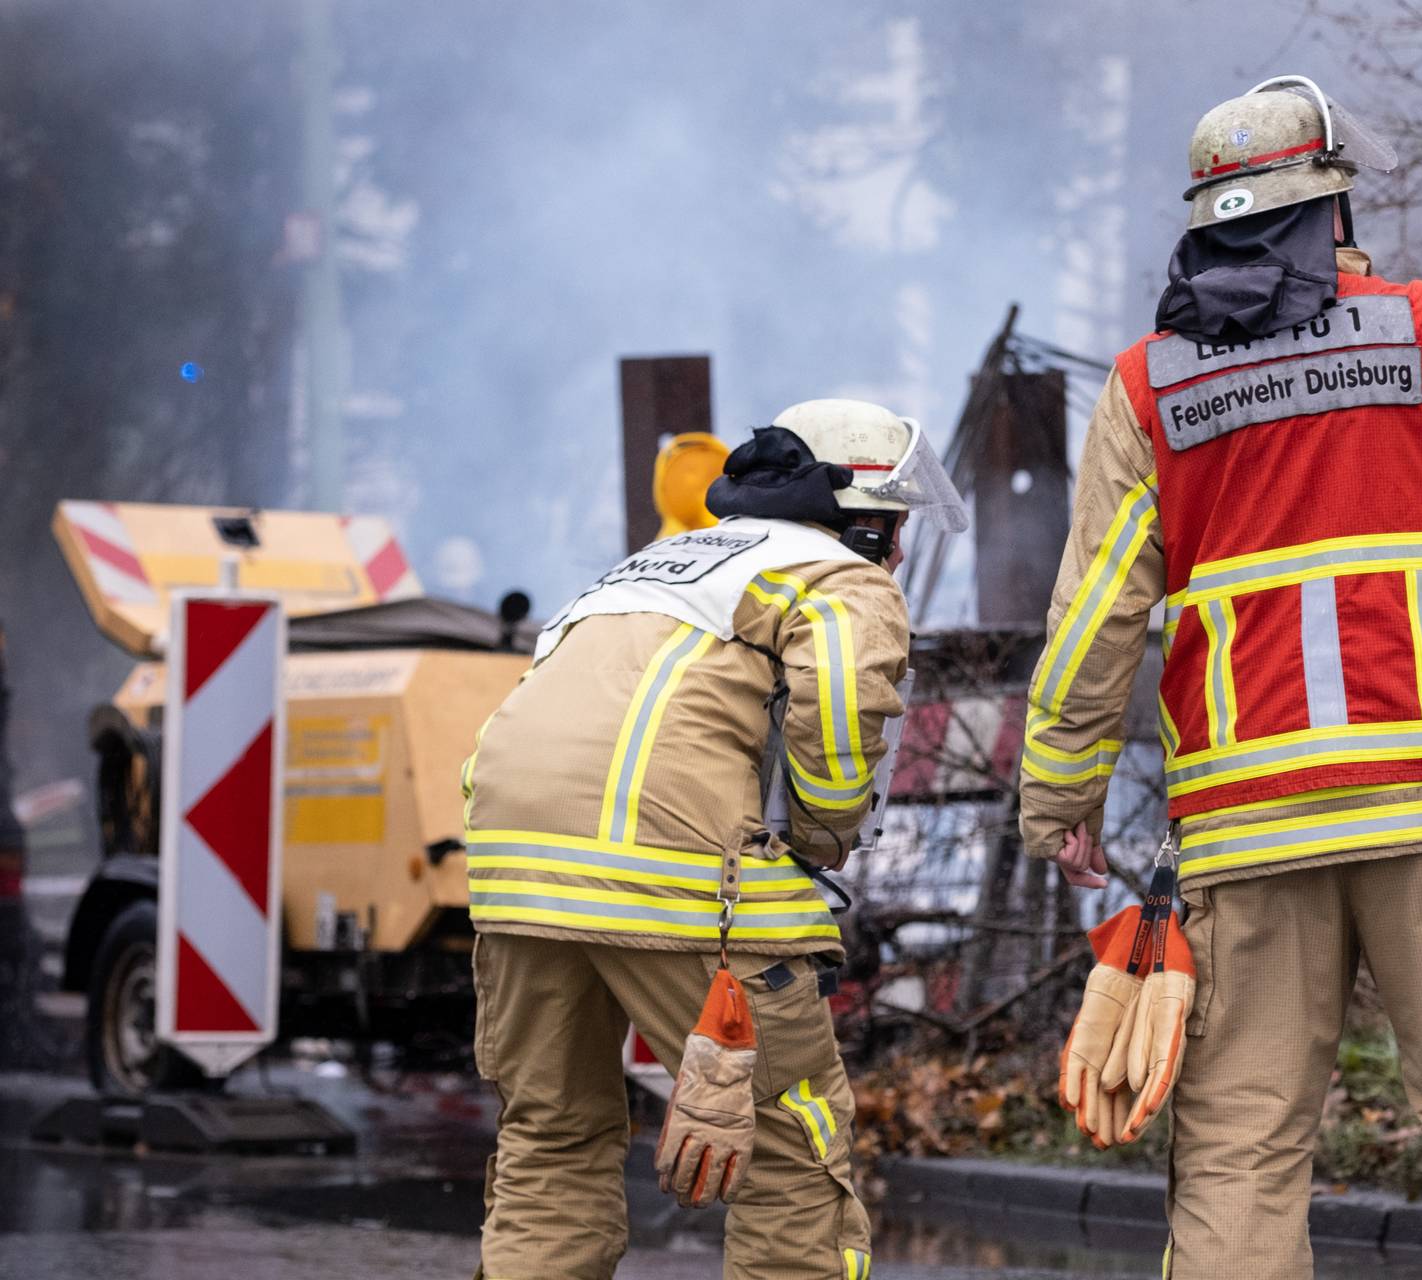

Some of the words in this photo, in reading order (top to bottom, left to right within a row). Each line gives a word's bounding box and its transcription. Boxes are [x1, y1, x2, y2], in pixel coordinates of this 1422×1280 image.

[1346, 306, 1362, 332] 1
[1170, 374, 1295, 432] Feuerwehr
[1304, 359, 1413, 393] Duisburg
[671, 534, 751, 549] Duisburg
[618, 559, 698, 575] Nord
